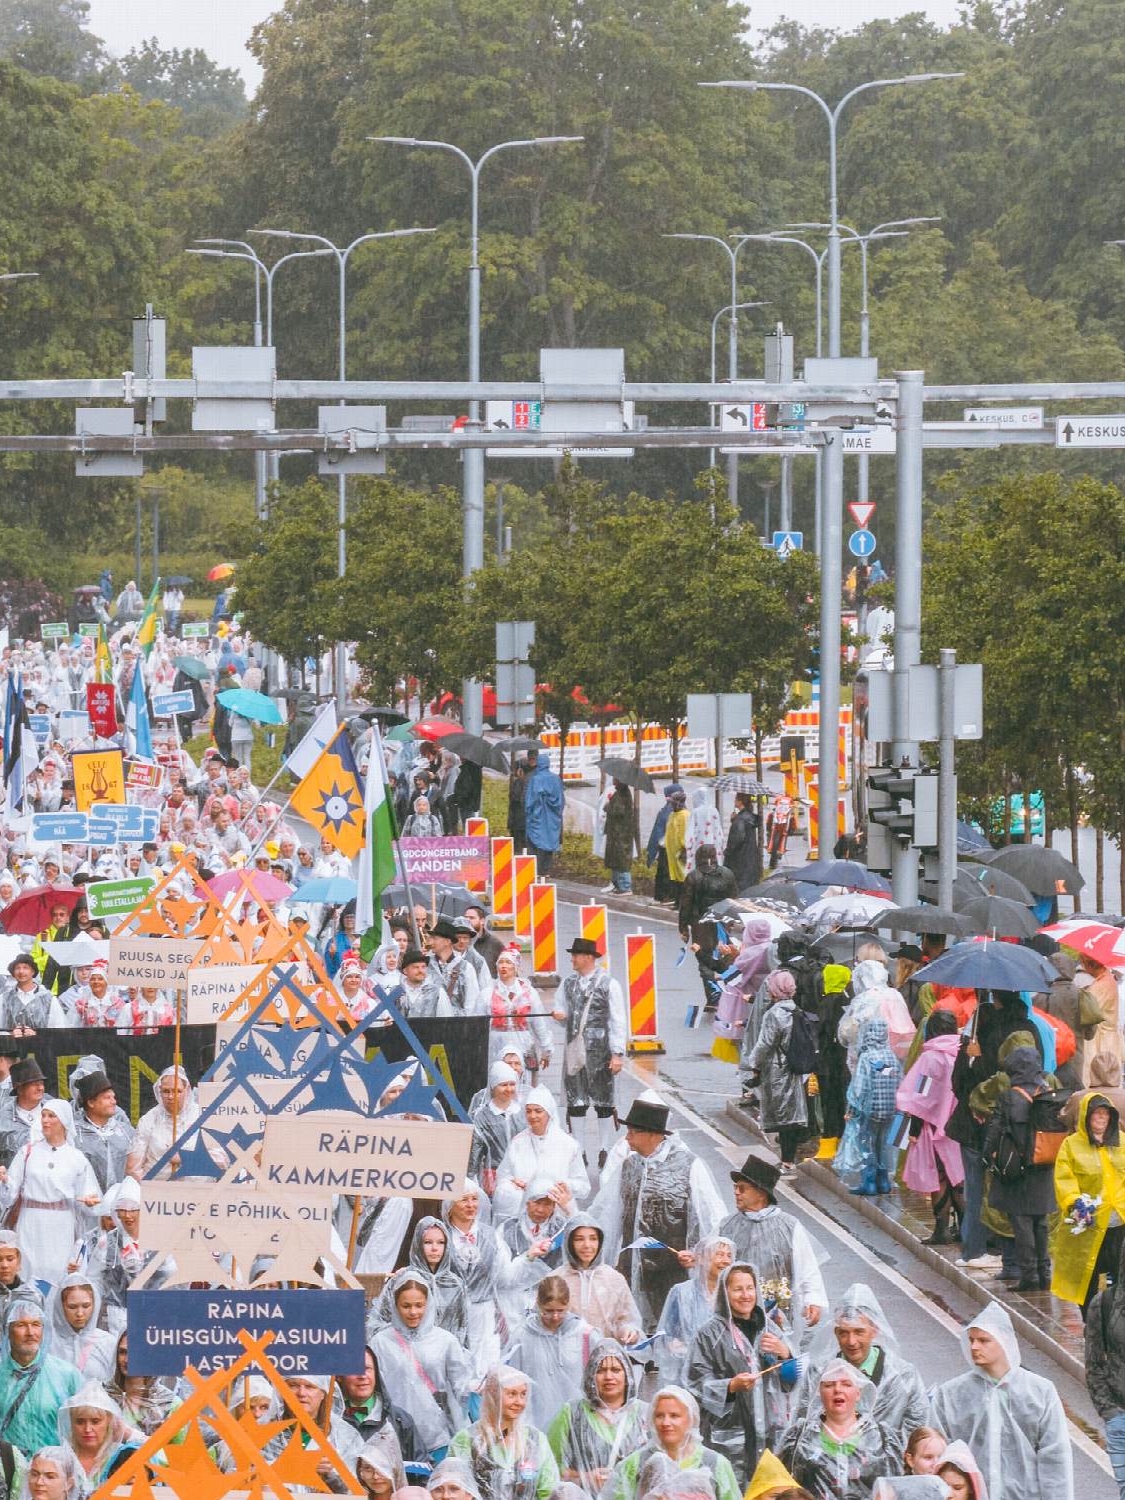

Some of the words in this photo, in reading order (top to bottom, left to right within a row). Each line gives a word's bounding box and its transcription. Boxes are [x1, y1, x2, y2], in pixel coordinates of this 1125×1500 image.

[405, 859, 462, 873] LANDEN
[119, 951, 163, 963] RUUSA
[117, 967, 166, 979] NAKSID
[191, 981, 236, 996] RÄPINA
[318, 1129, 413, 1157] RÄPINA
[268, 1163, 456, 1192] KAMMERKOOR
[144, 1200, 219, 1217] VILUSE
[226, 1201, 328, 1221] PÕHIKOLI
[207, 1300, 285, 1319] RÄPINA
